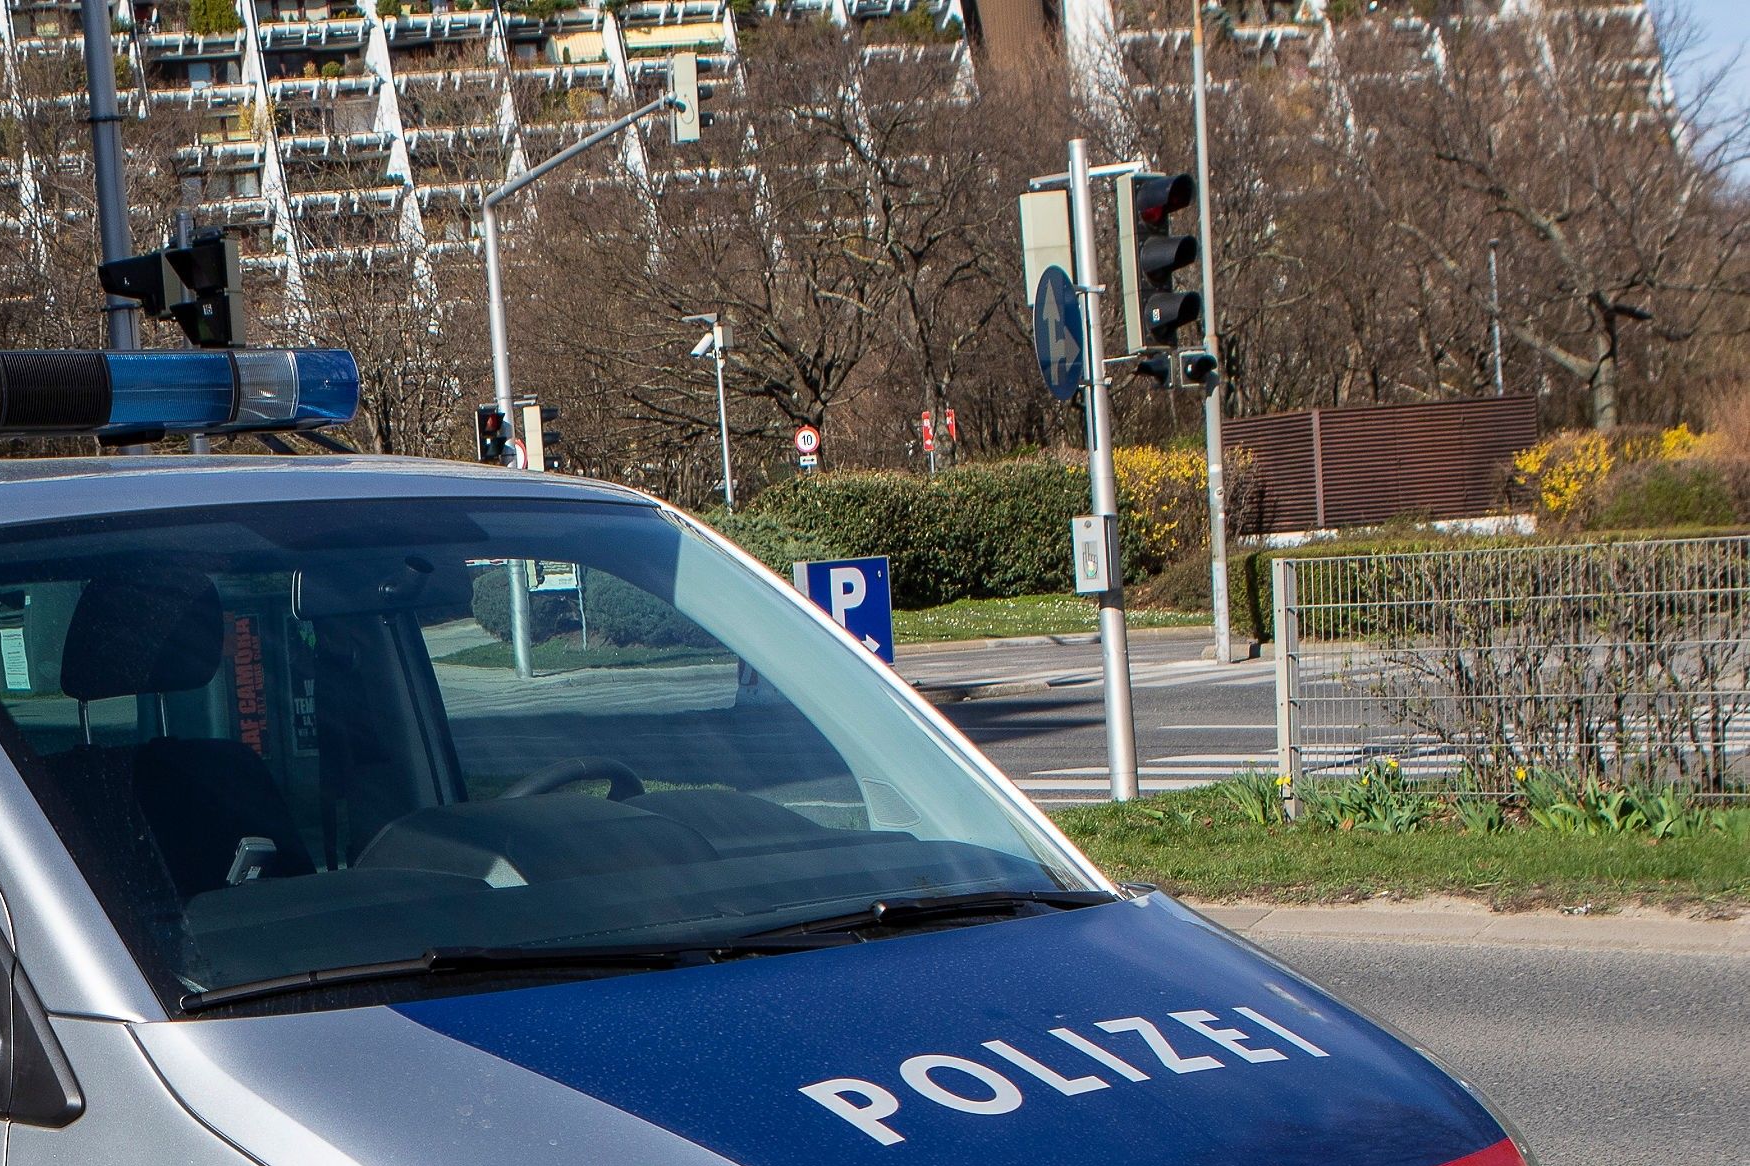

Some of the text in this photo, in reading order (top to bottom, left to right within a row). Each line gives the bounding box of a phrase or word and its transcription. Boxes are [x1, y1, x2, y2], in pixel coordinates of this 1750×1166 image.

[801, 434, 813, 446] 10
[830, 567, 866, 628] P
[798, 1006, 1330, 1146] POLIZEI
